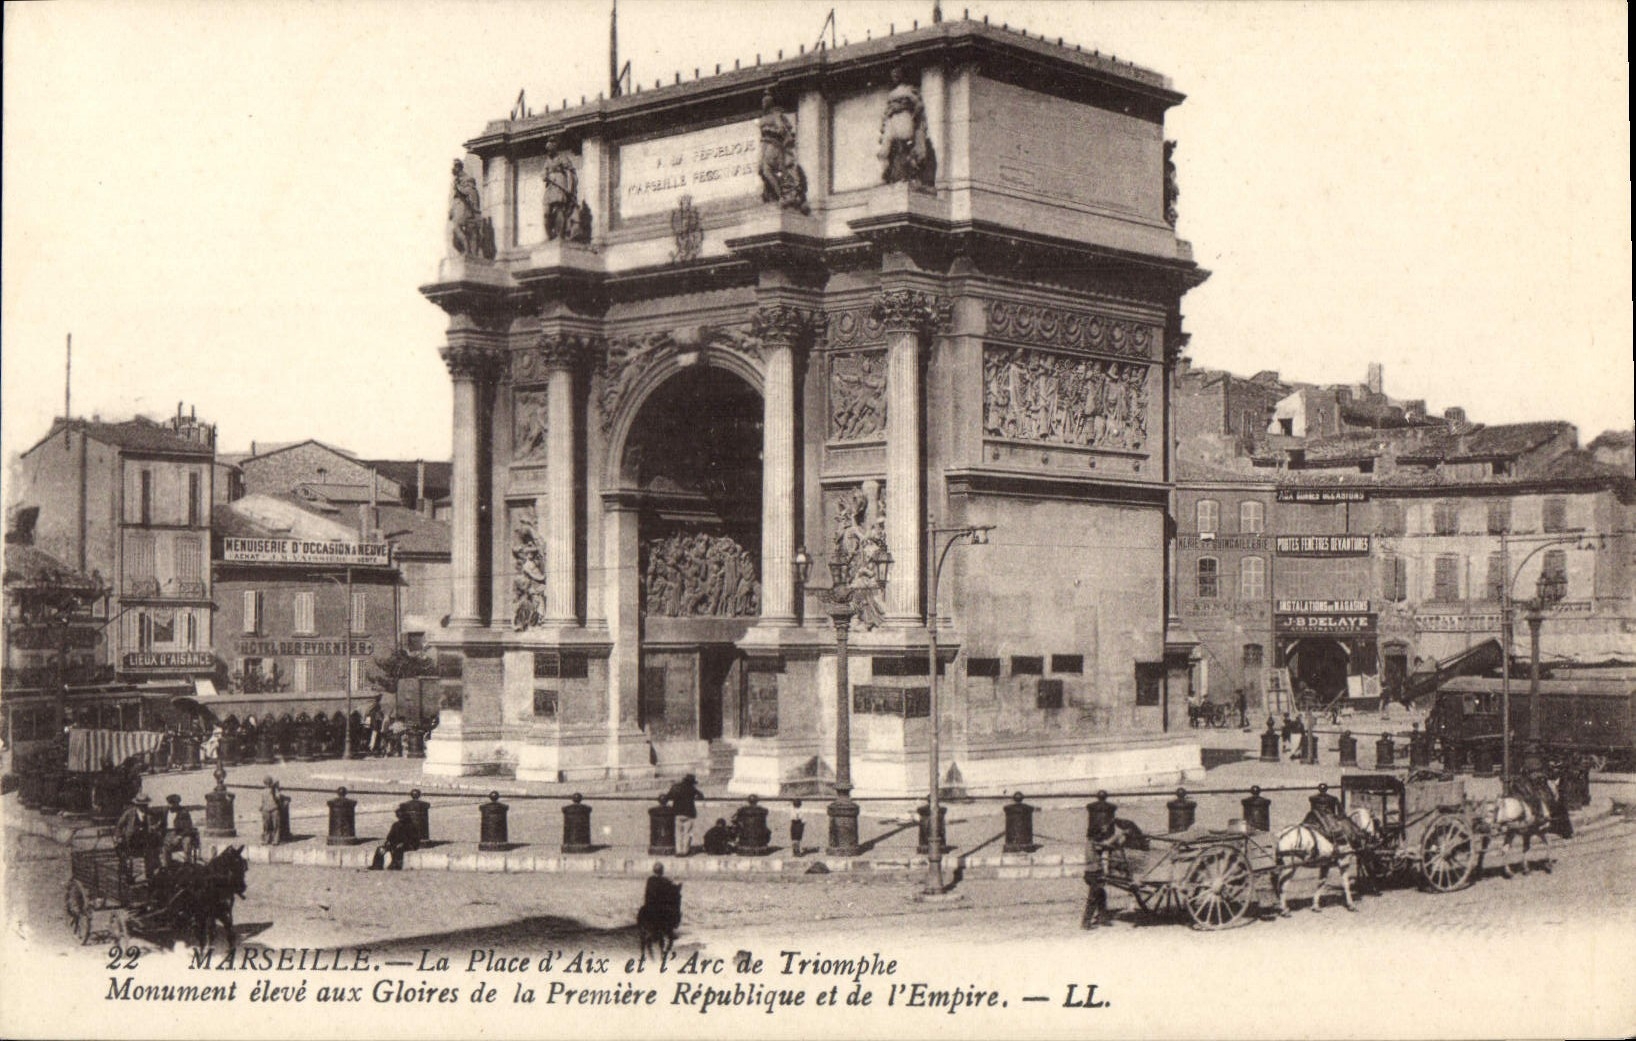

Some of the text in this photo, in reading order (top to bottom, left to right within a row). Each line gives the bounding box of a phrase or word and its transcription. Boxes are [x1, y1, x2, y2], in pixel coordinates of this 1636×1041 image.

[628, 175, 687, 195] MARSEILLE
[226, 538, 288, 554] MENUISERIE
[291, 540, 350, 556] D'OCCASION
[357, 543, 387, 557] NEUVE
[1277, 537, 1299, 551] PORTES
[1330, 537, 1368, 551] DEVANTURES
[1334, 600, 1368, 611] MAGASINS
[1308, 616, 1368, 627] DELAYE
[280, 641, 301, 655] DES
[130, 653, 211, 666] LIEUX D'AISANCE
